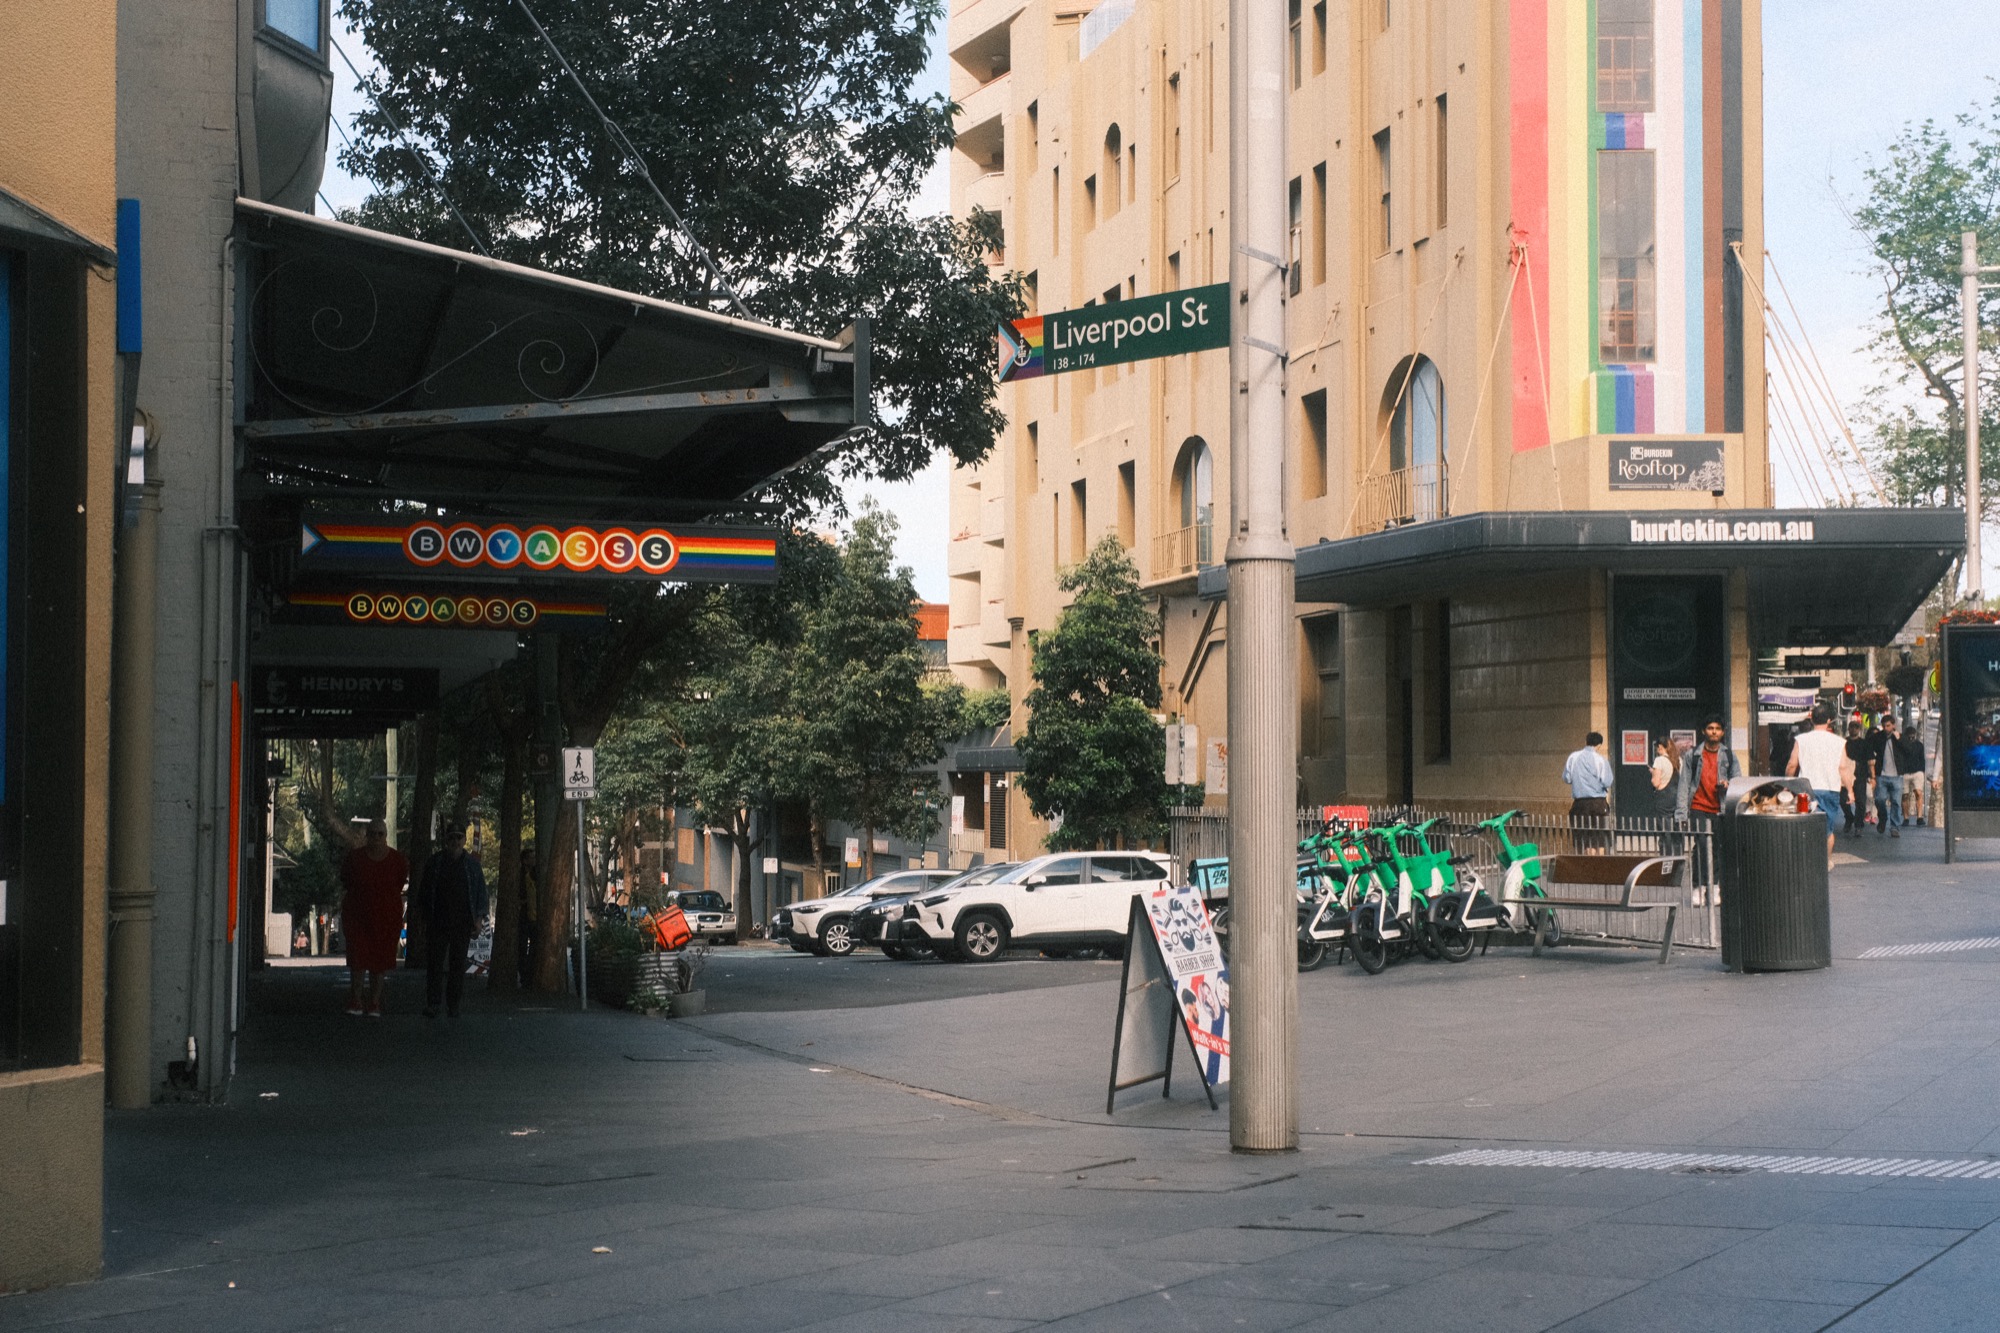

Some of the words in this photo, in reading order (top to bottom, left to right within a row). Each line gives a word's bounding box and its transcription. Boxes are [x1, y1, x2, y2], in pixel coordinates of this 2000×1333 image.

[1053, 301, 1171, 350] Liverpool
[1181, 297, 1209, 328] St
[1053, 356, 1069, 370] 138
[1078, 353, 1095, 367] 174
[1643, 448, 1673, 458] BURDEKIN
[1618, 459, 1686, 481] Rooftop
[1630, 518, 1814, 542] burdekin.com.au
[301, 676, 405, 692] HENDRY'S
[1970, 769, 1999, 777] Nothing
[1174, 956, 1201, 973] BARBER
[1199, 953, 1216, 968] SHOP
